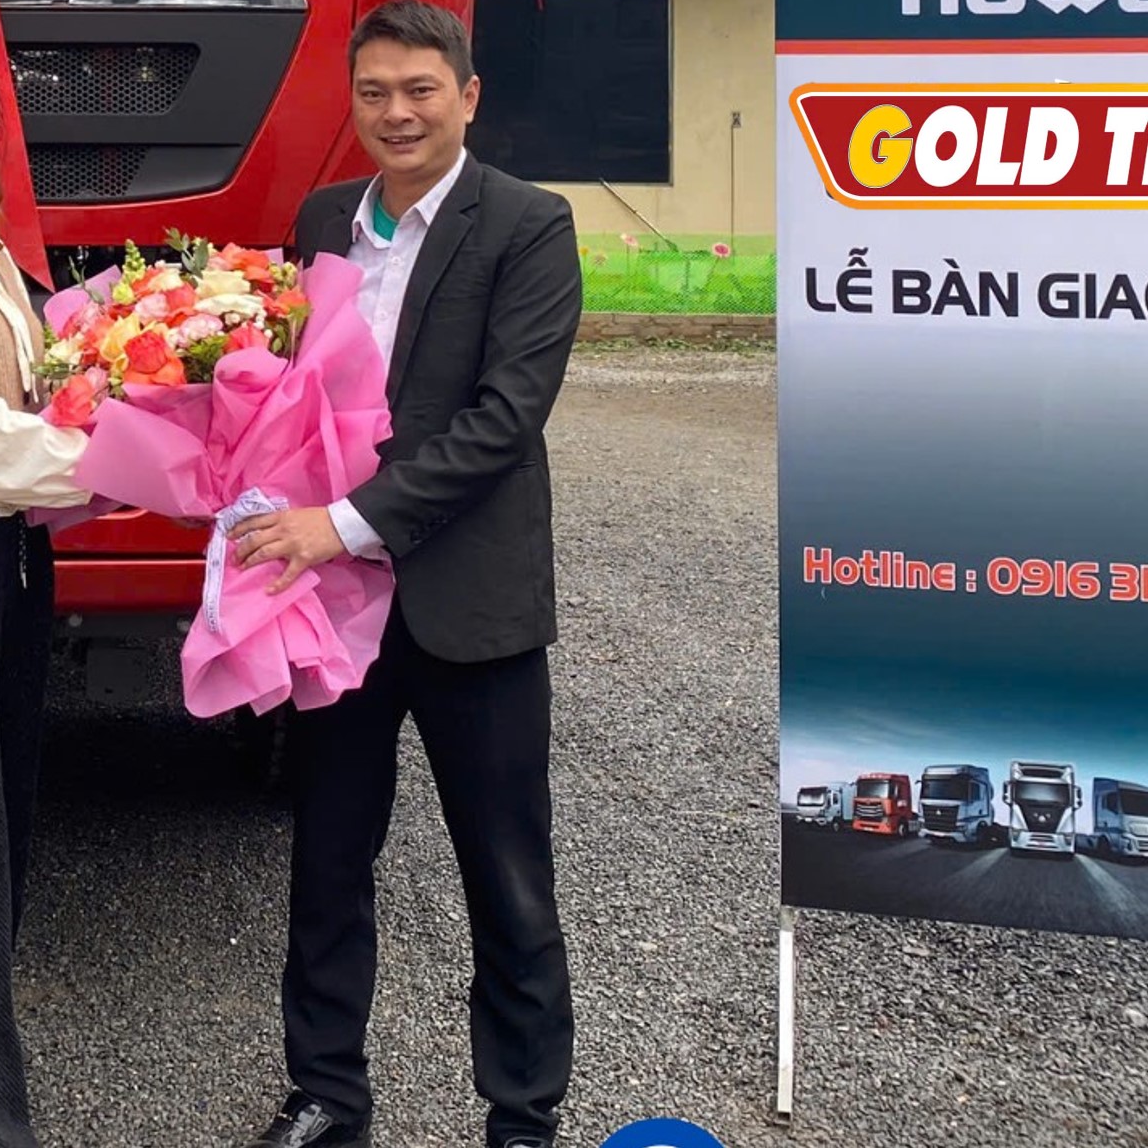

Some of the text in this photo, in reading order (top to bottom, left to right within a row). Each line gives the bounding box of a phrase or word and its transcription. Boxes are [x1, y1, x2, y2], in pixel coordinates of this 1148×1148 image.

[805, 247, 1148, 320] LỄ BÀN GIA
[803, 547, 956, 592] Hotline
[986, 557, 1101, 600] 0916
